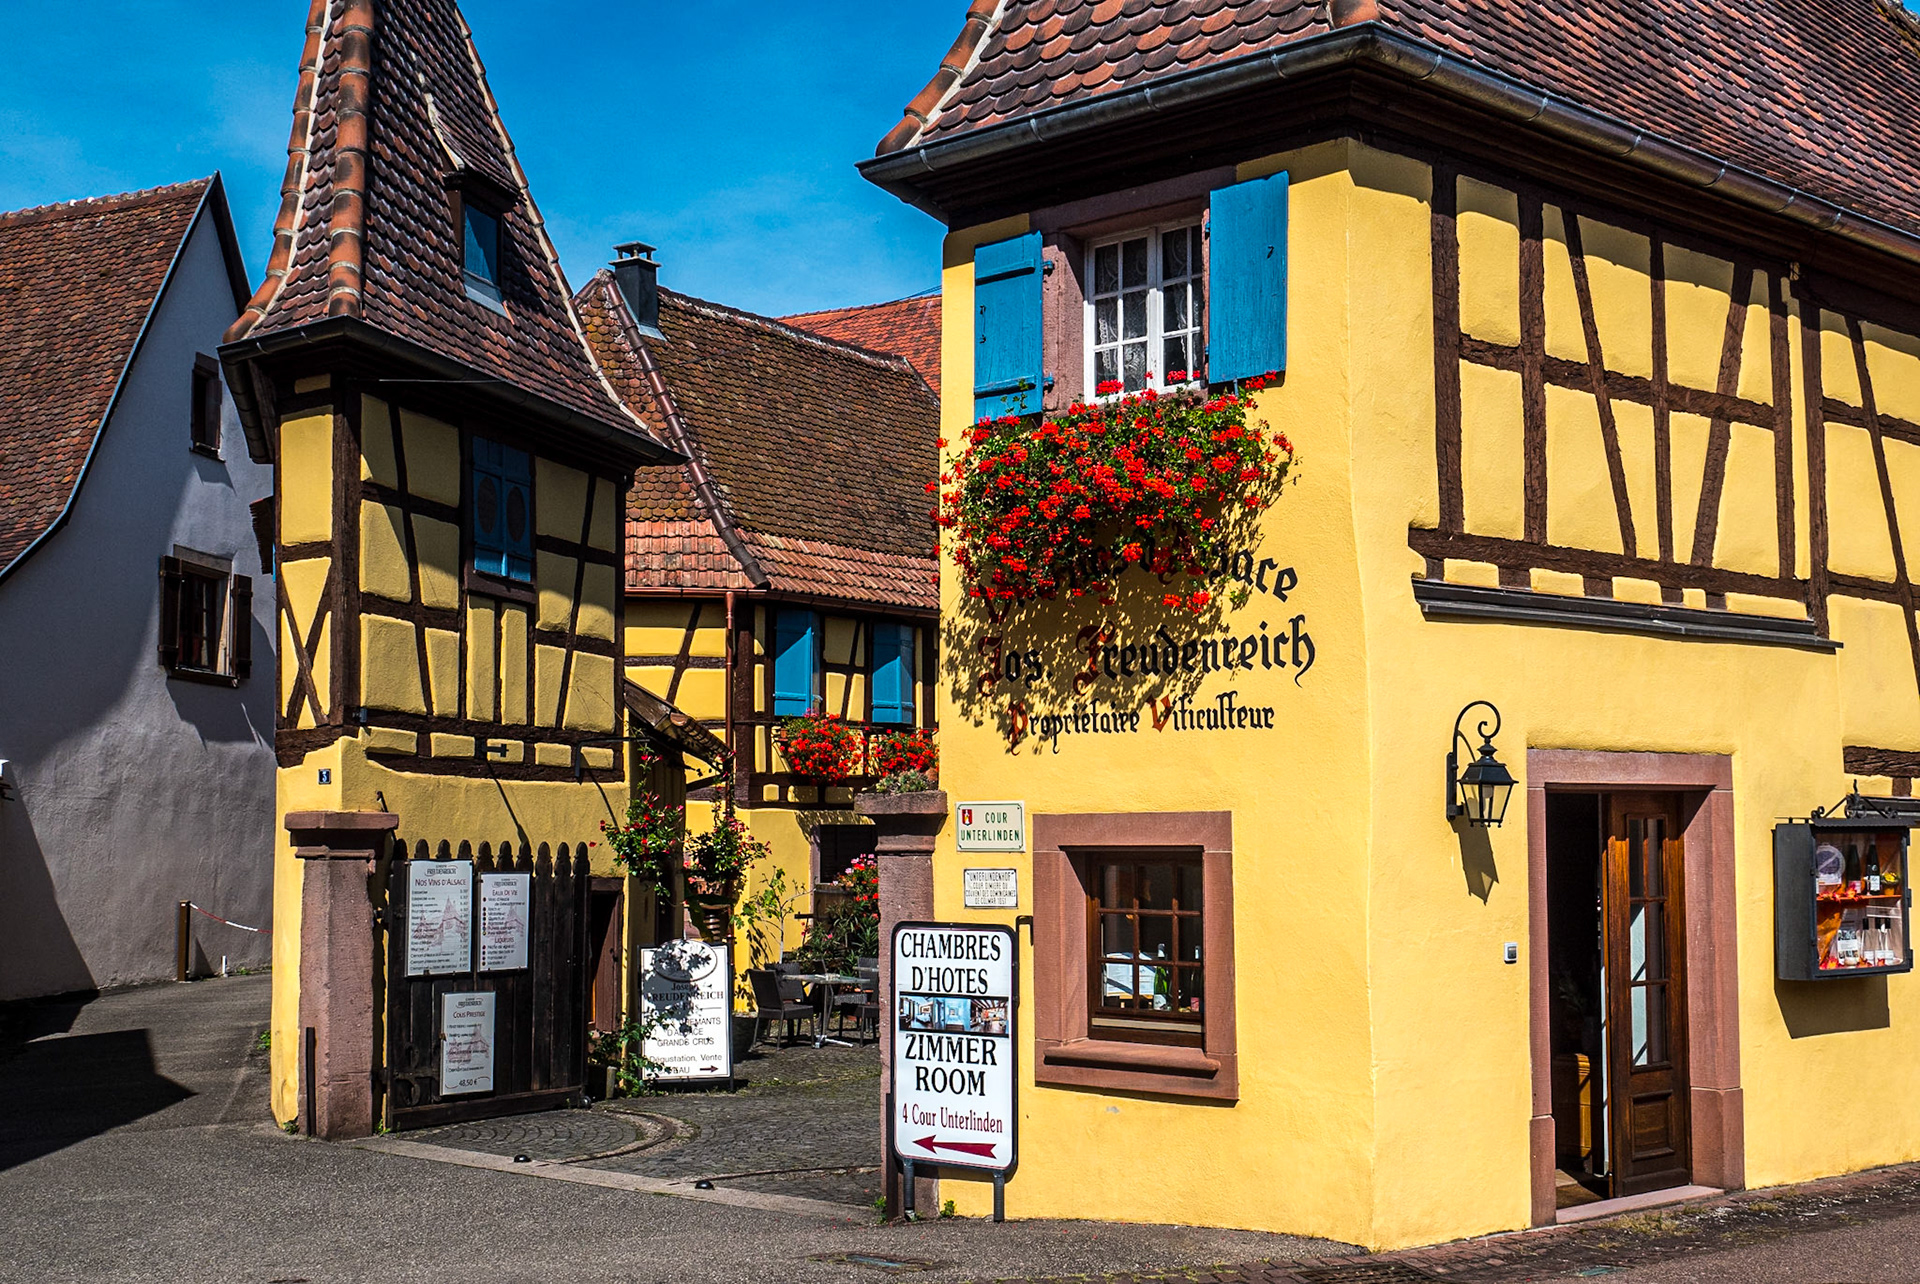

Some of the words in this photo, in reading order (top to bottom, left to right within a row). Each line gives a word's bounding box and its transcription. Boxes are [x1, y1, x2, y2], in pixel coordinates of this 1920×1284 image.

[1072, 613, 1316, 697] Freudenreich
[1007, 697, 1140, 756] Propriétaire
[1147, 690, 1275, 734] Viticulteur
[984, 811, 1008, 824] COUR
[960, 829, 1020, 841] UNTERLINDEN
[414, 878, 427, 887] NOS
[428, 878, 441, 886] VINS
[900, 932, 1001, 962] CHAMBRES
[911, 966, 989, 995] D'HOTES
[692, 1037, 715, 1047] CRUS
[904, 1033, 998, 1066] ZIMMER
[700, 1053, 723, 1062] Vente
[914, 1065, 986, 1097] ROOM
[902, 1103, 908, 1124] 4
[911, 1103, 937, 1128] Cour
[940, 1107, 1003, 1134] Unterlinden
